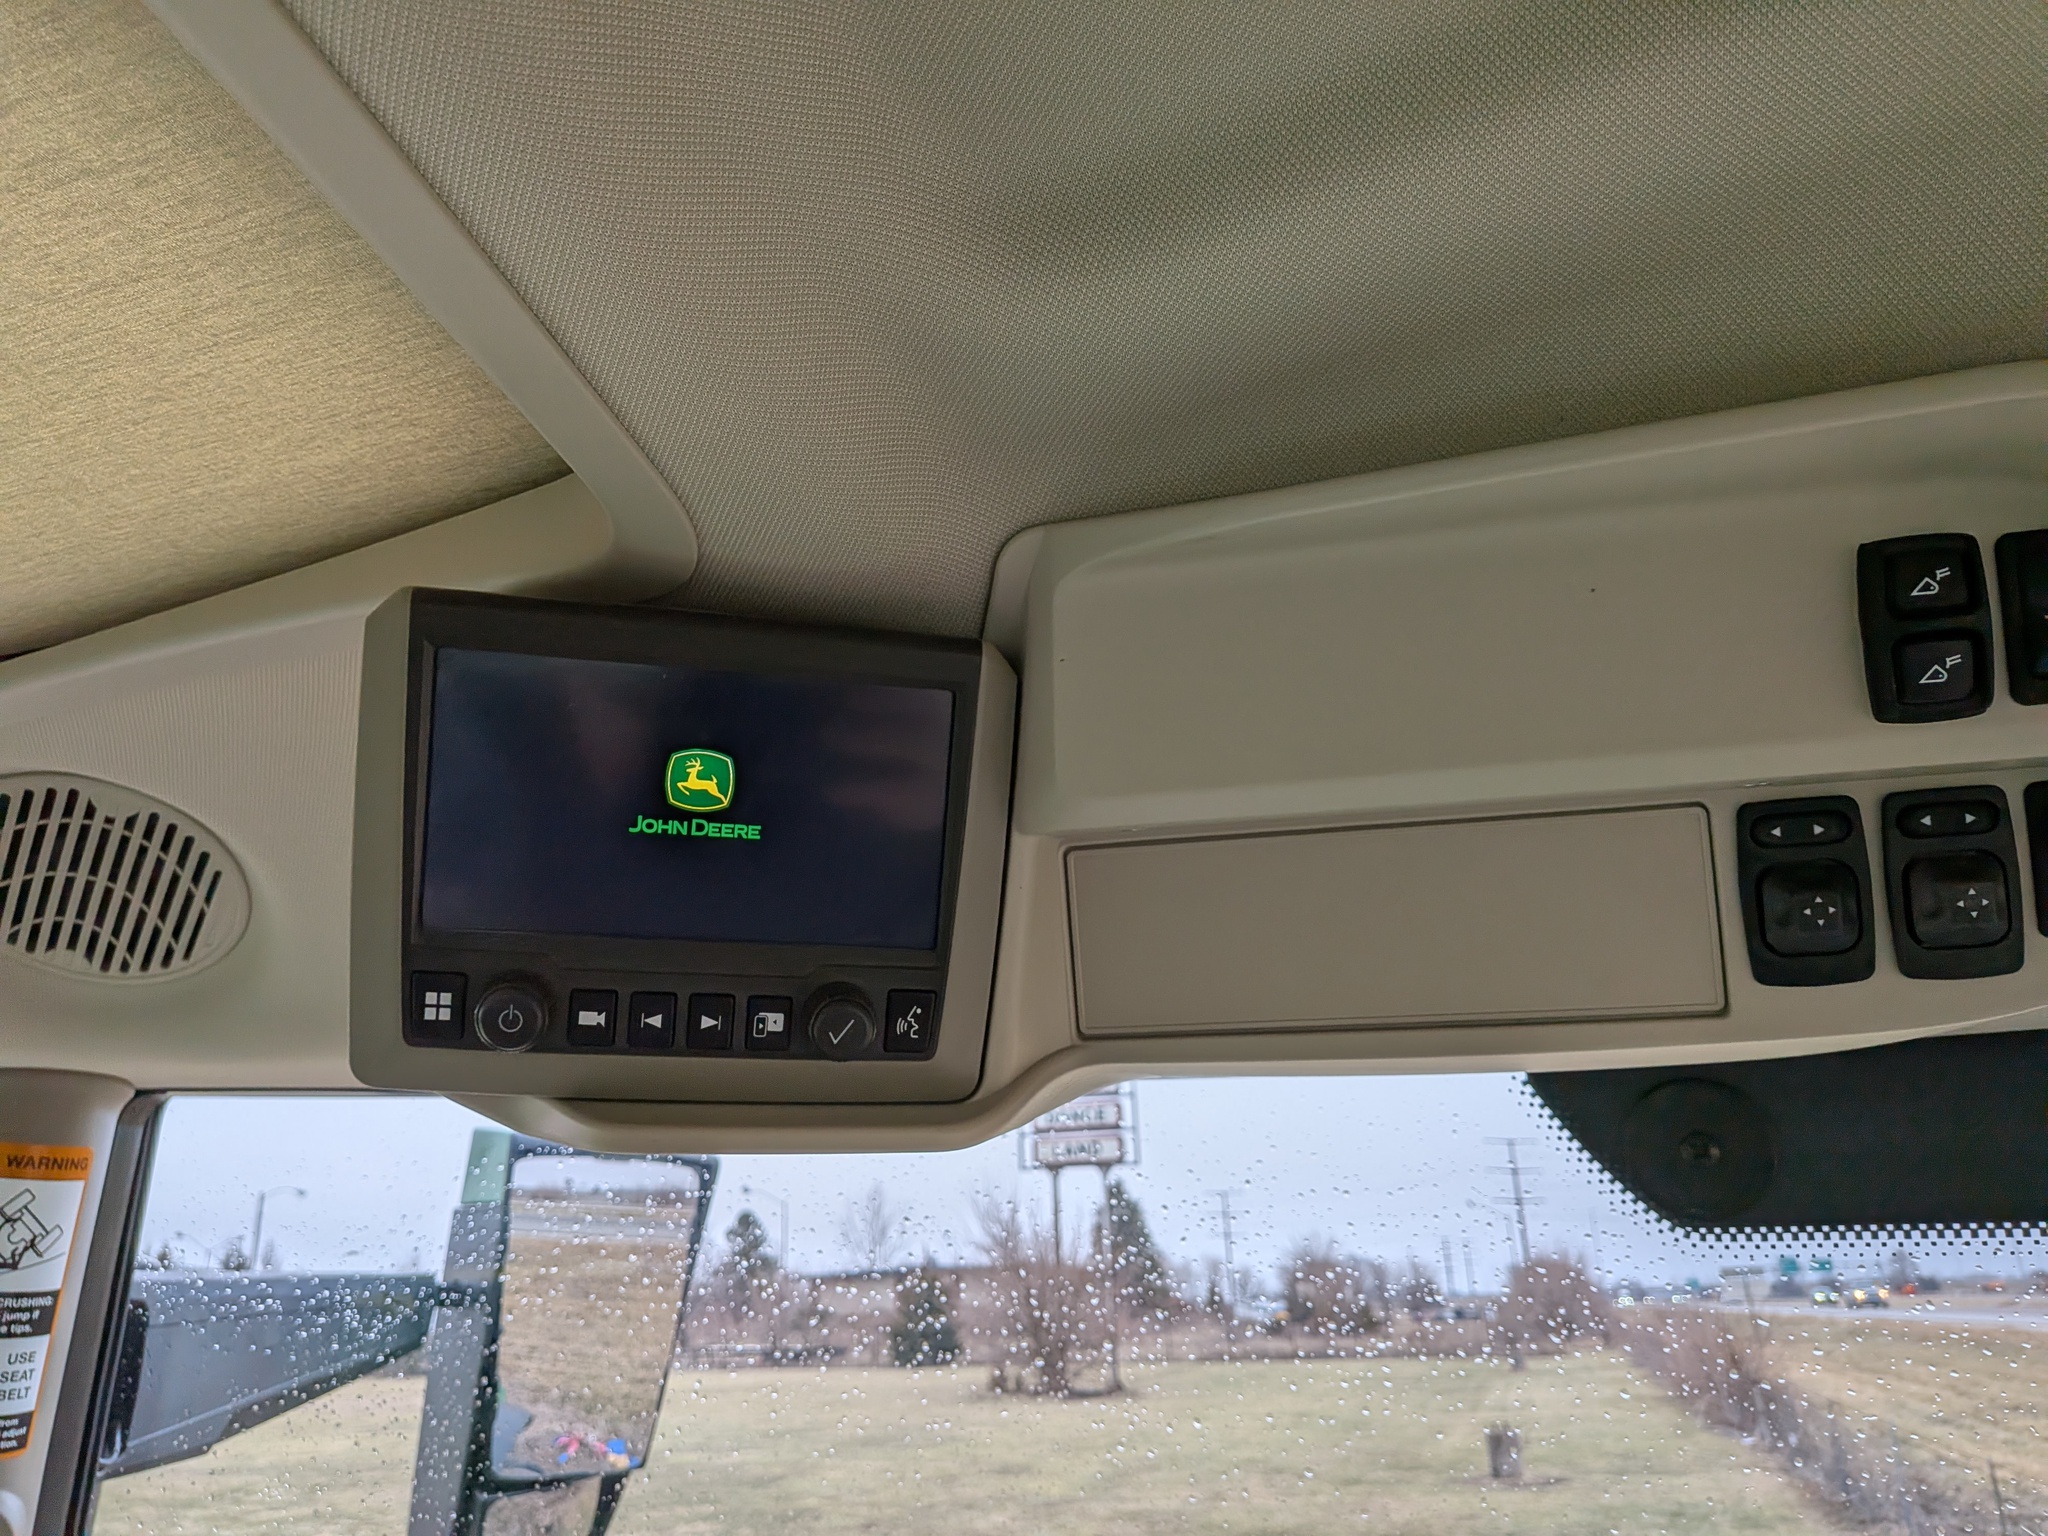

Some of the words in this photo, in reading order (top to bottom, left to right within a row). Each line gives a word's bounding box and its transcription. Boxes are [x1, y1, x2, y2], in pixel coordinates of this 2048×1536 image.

[628, 815, 688, 835] JOHN
[691, 818, 762, 839] DEERE
[6, 1154, 89, 1171] WARNING
[7, 1350, 37, 1365] USE
[0, 1368, 36, 1383] SEAT
